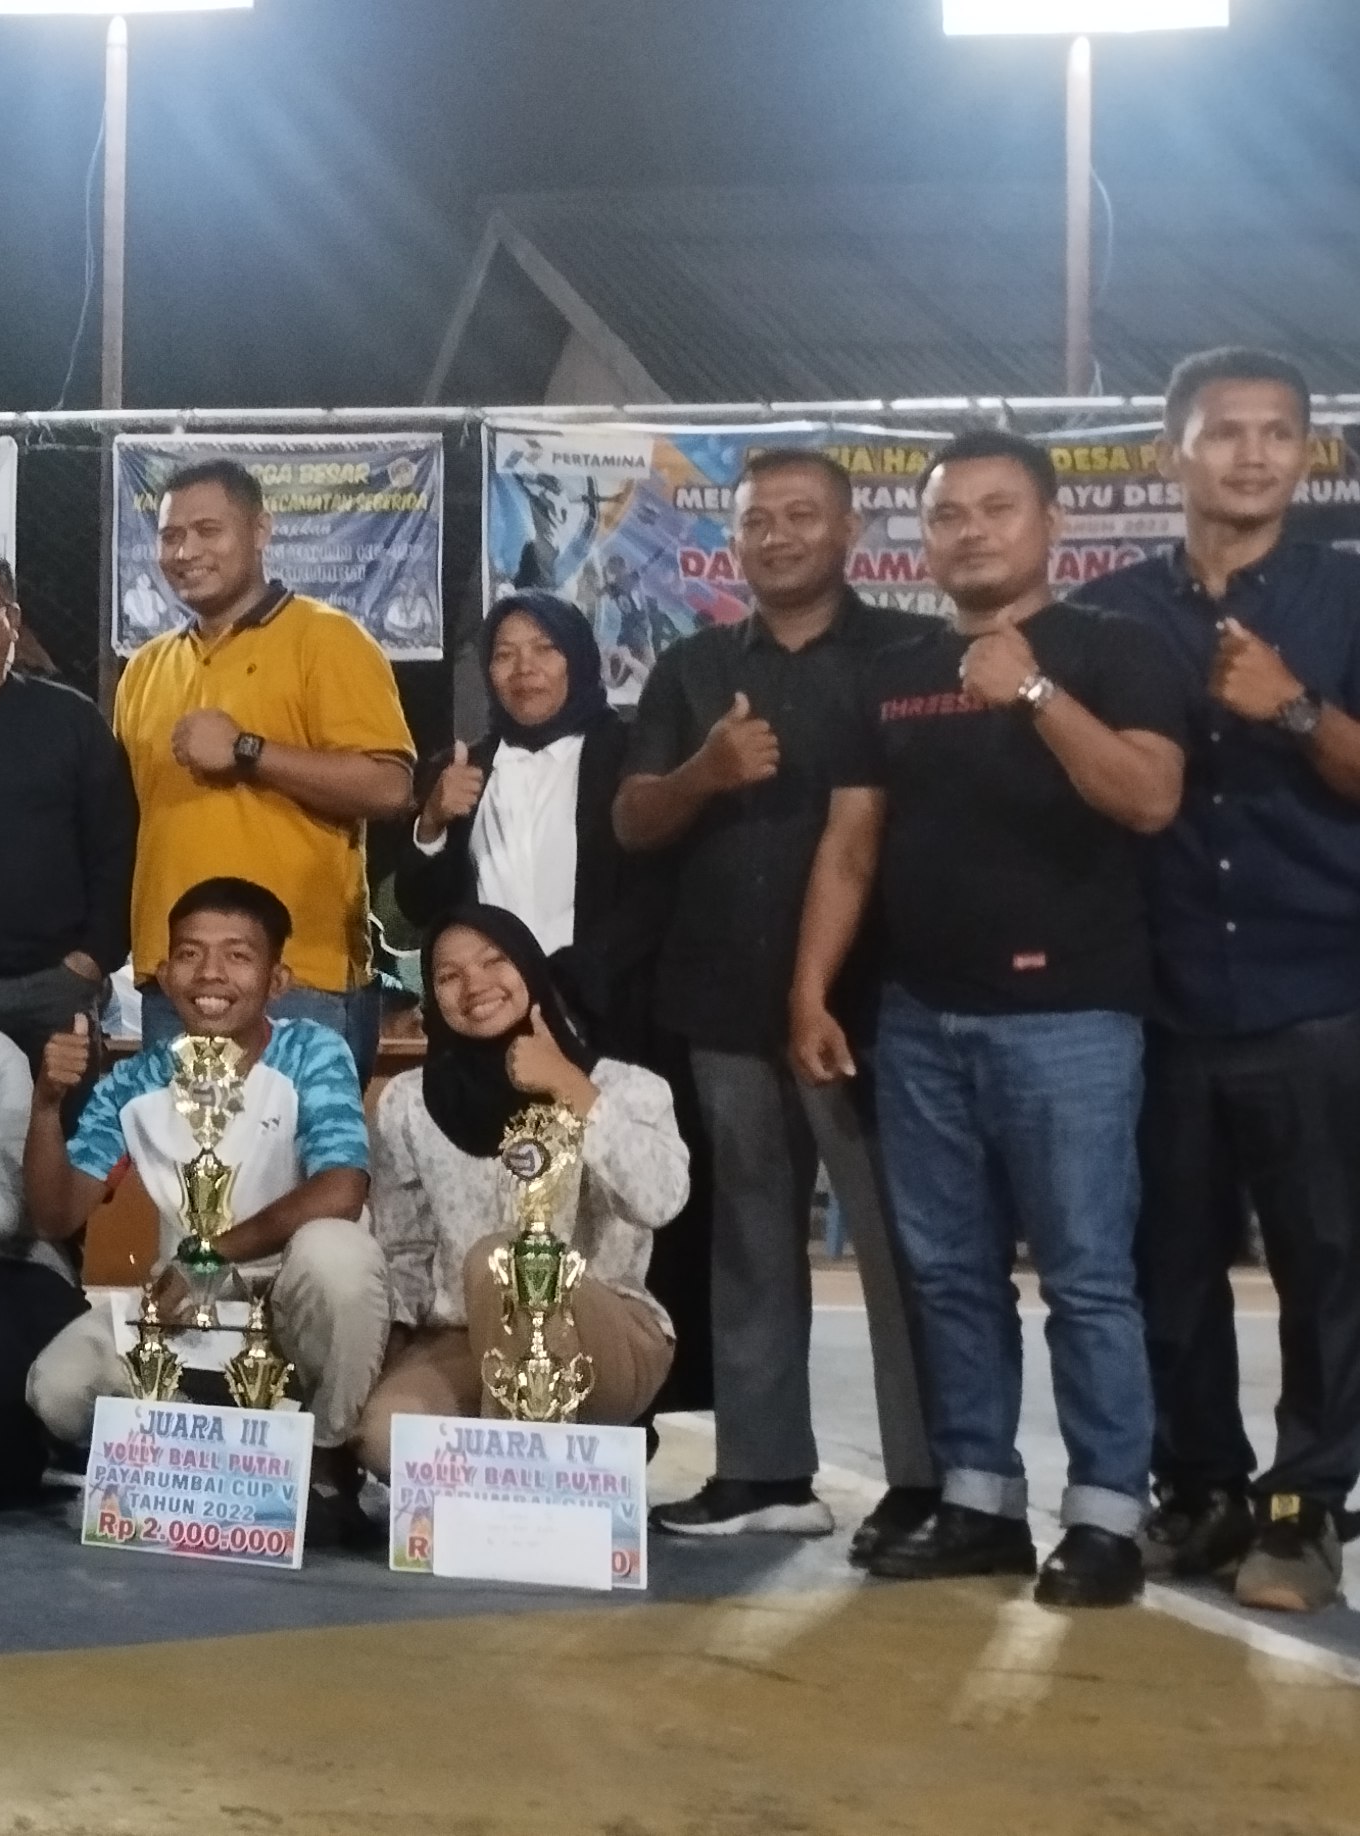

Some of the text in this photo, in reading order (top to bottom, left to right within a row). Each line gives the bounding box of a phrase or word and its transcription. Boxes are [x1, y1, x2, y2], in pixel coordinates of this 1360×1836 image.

[552, 452, 646, 468] PERTAMINA
[1051, 447, 1130, 472] DESA
[140, 1411, 270, 1446] JUARA III
[104, 1441, 291, 1476] VOLLY BALL PUTRI
[446, 1428, 599, 1464] JUARA IV
[95, 1466, 294, 1499] PAYARUMBAI CUP V
[405, 1461, 628, 1494] VOLLY BALL PUTRI
[131, 1493, 254, 1520] TAHUN 2022
[99, 1512, 286, 1553] Rp 2.000.000
